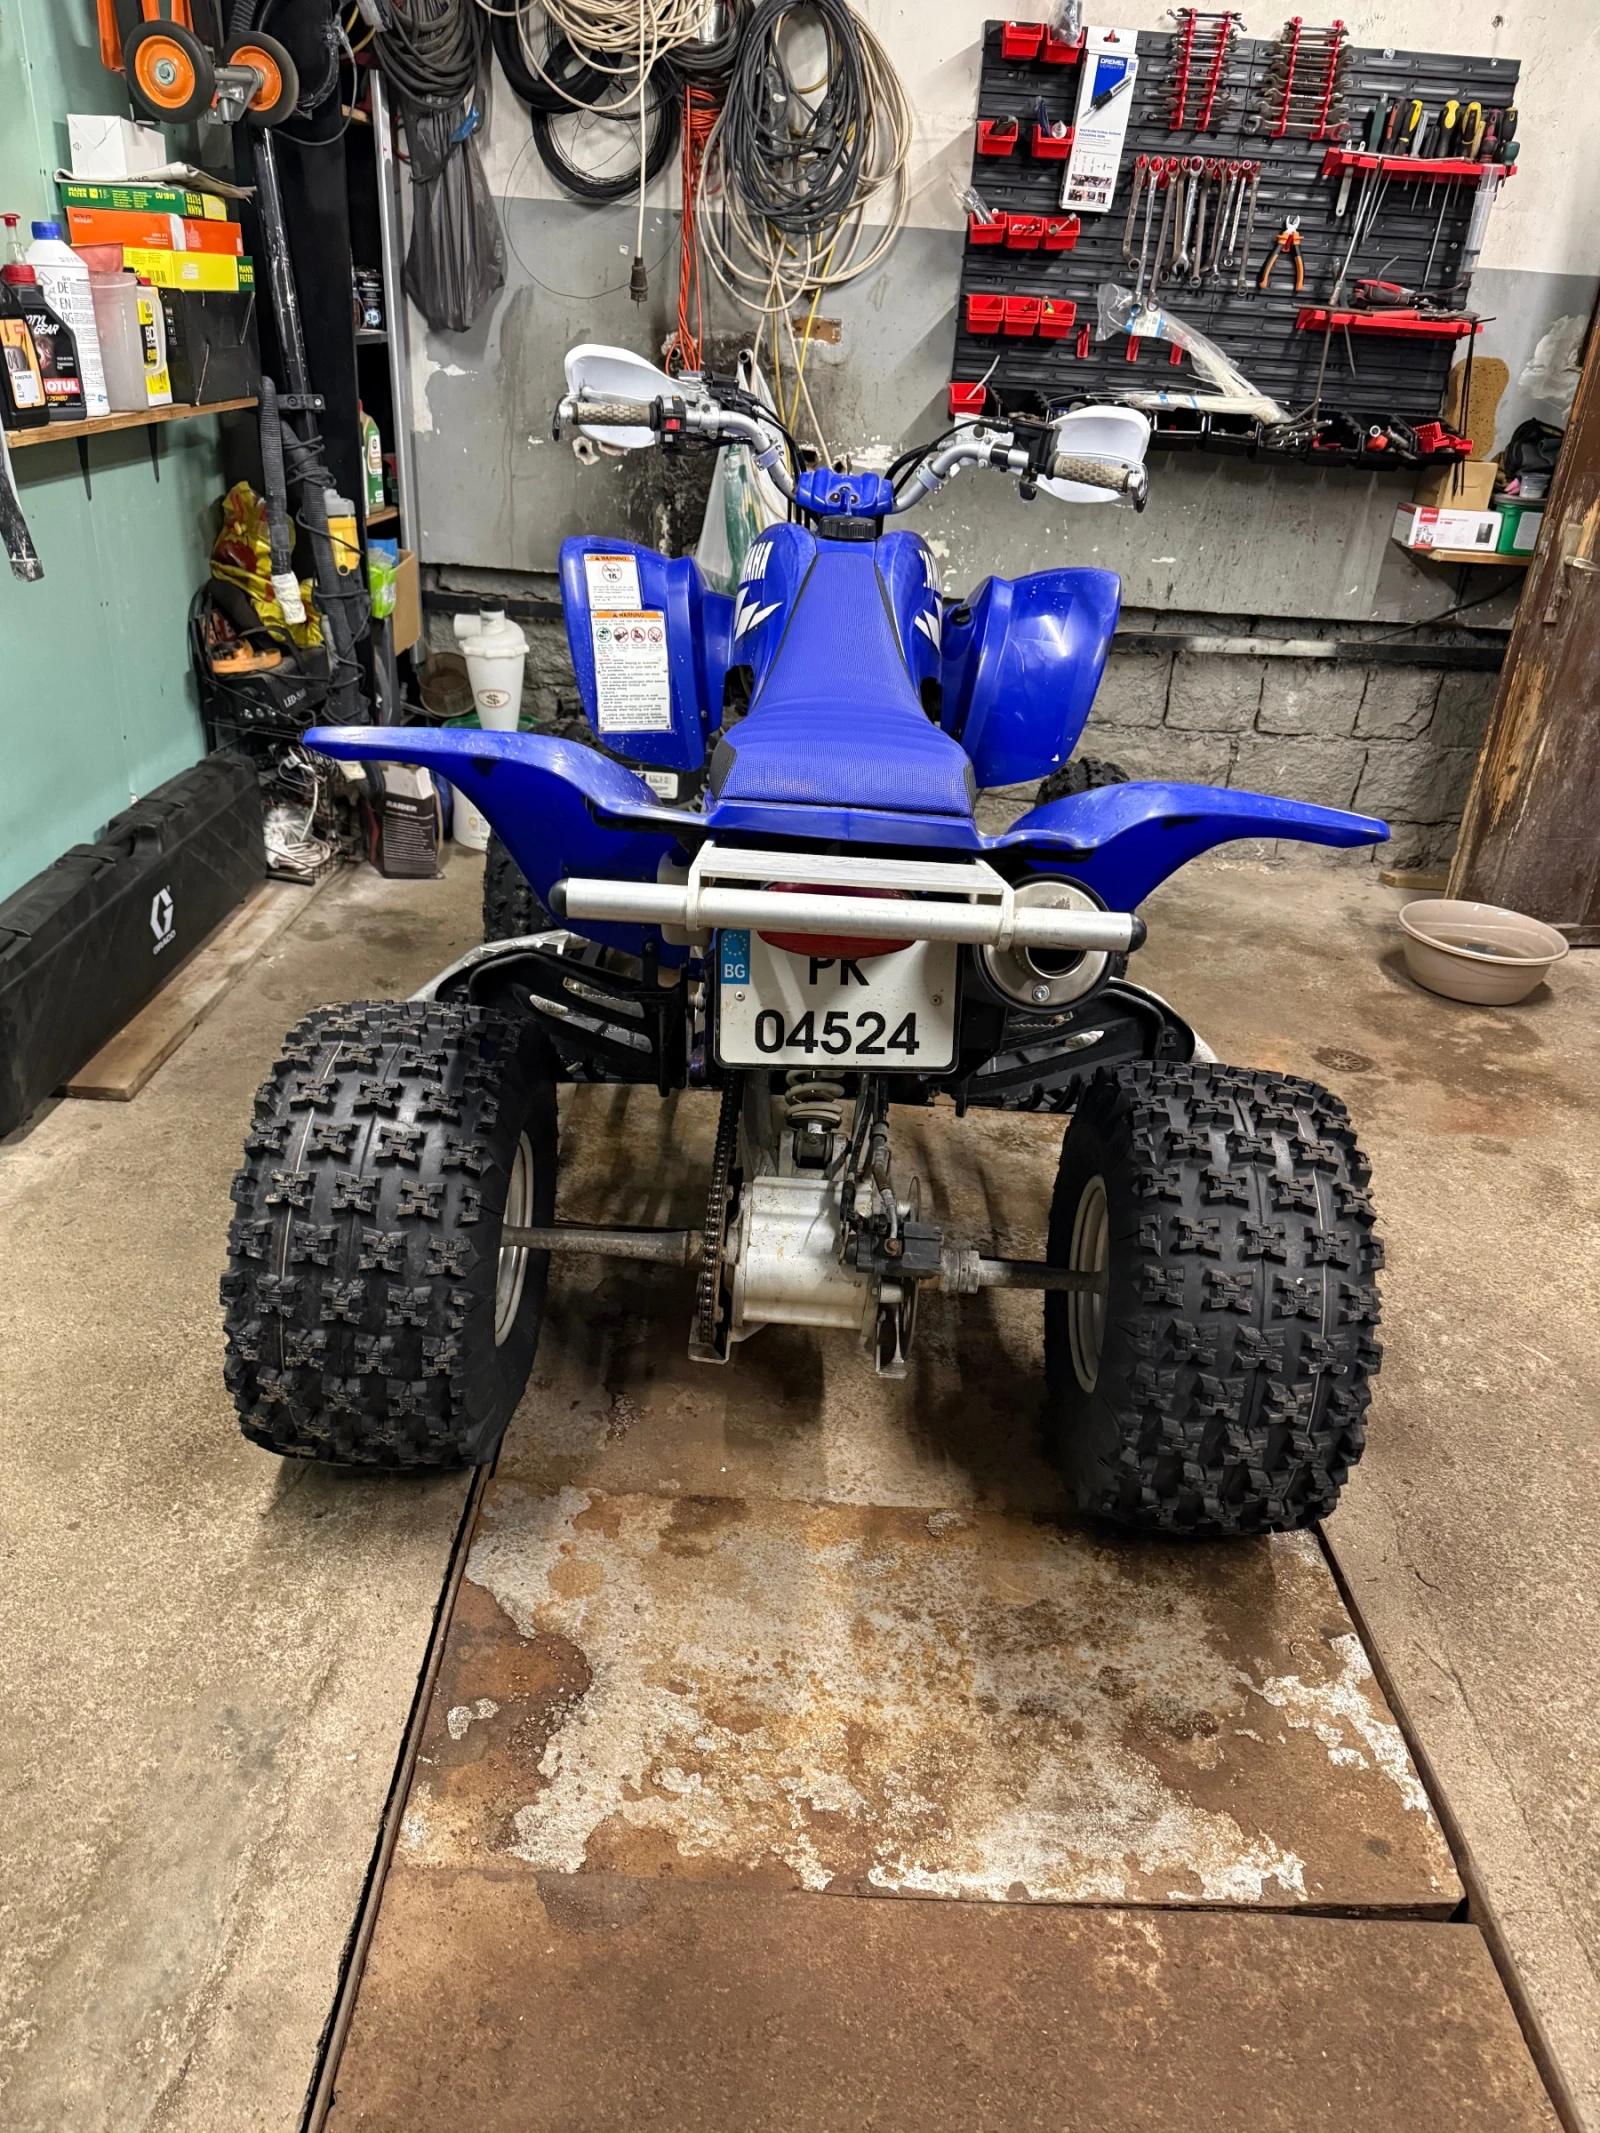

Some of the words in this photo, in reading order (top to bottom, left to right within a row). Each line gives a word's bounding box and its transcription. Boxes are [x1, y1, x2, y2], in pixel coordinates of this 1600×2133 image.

[1100, 58, 1125, 66] DREMEL
[238, 265, 253, 273] MANN
[239, 274, 254, 283] FILTER
[57, 282, 69, 294] DE
[60, 298, 71, 310] EN
[34, 324, 60, 335] GEAR
[386, 800, 418, 813] RAIDER
[152, 929, 177, 955] GRACO
[724, 964, 746, 979] BG
[755, 1009, 919, 1056] 04524
